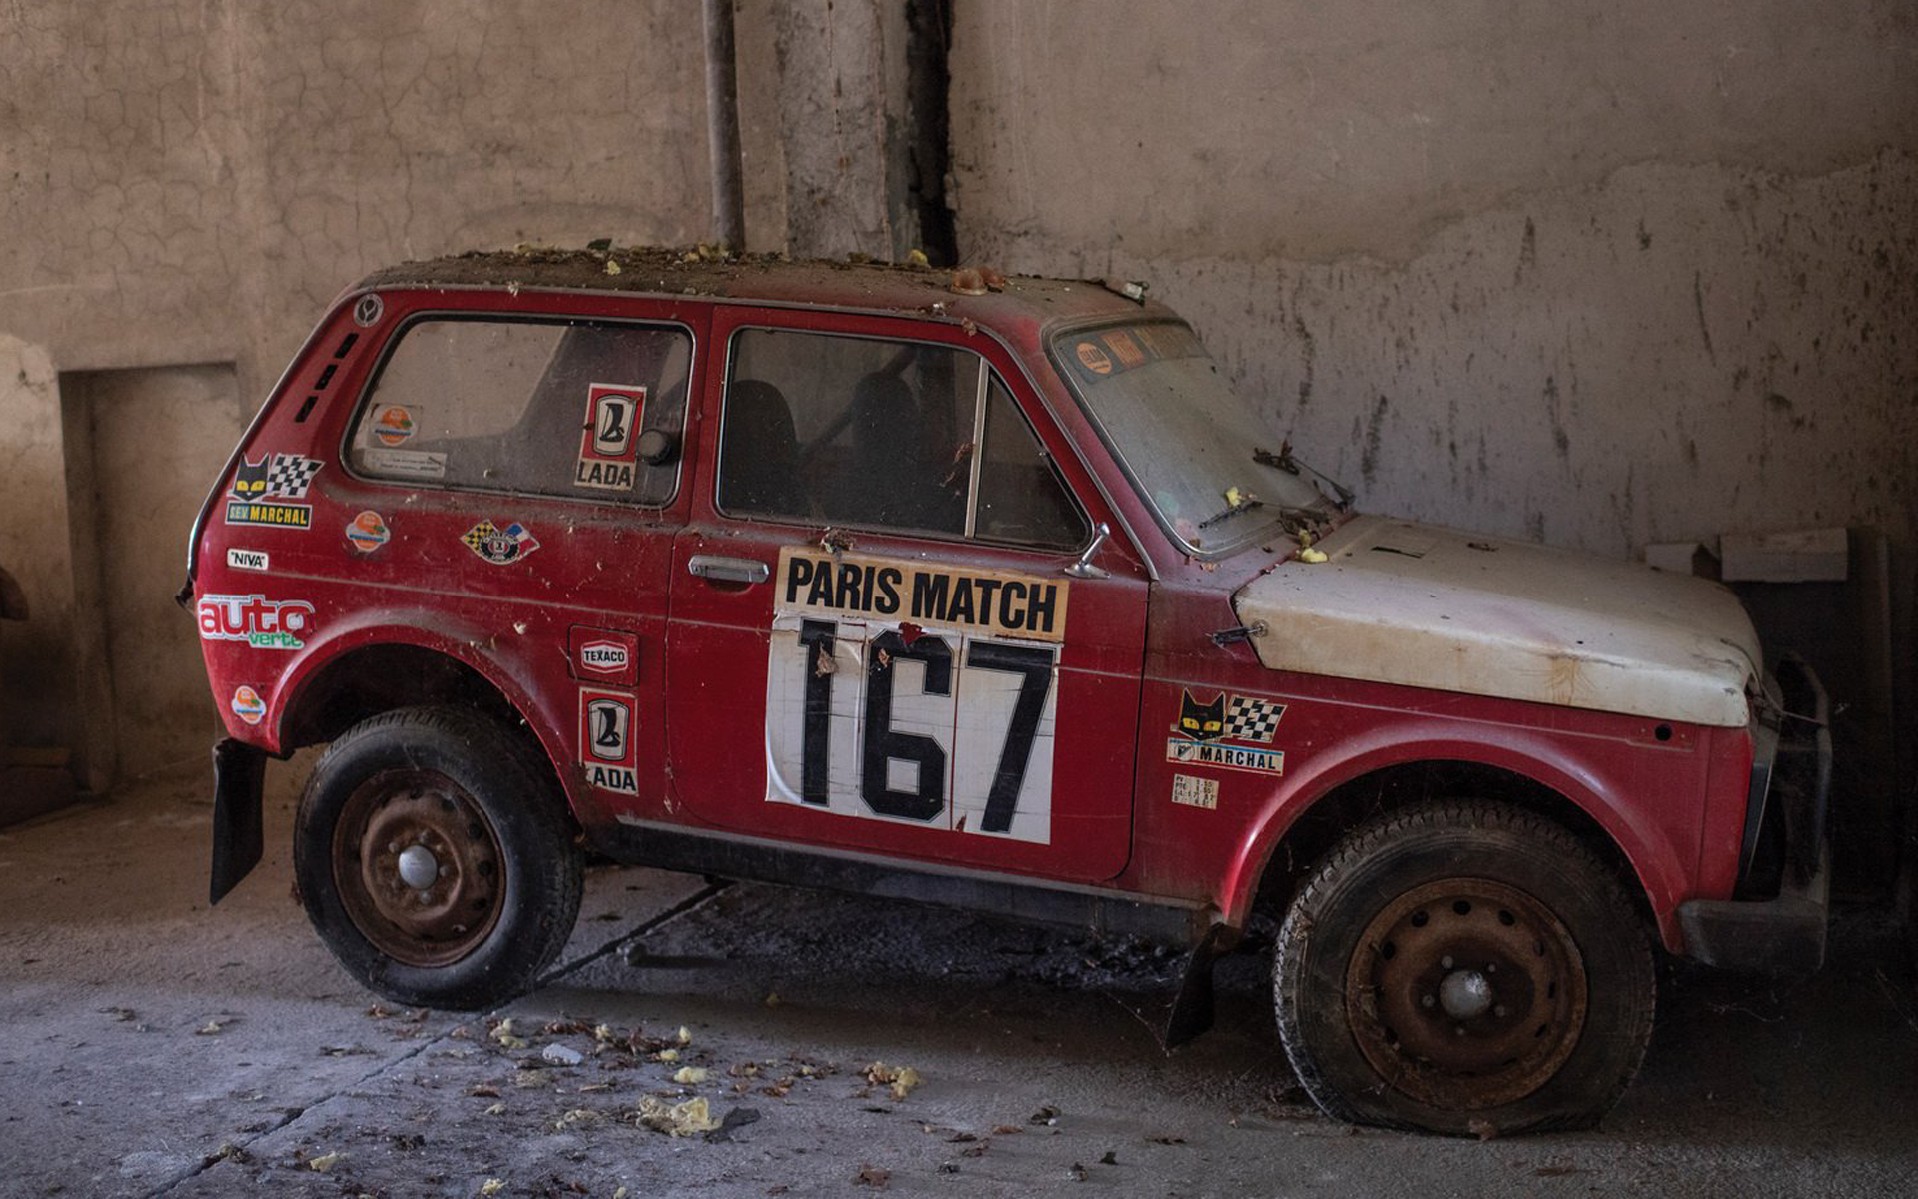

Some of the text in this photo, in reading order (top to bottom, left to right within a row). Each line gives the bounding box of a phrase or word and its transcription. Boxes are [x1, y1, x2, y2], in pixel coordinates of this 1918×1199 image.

[577, 462, 631, 486] LADA
[250, 506, 307, 525] MARCHAL
[787, 557, 1057, 633] PARIS MATCH
[200, 597, 314, 636] auto
[584, 651, 625, 662] TEXACO
[798, 615, 1057, 833] 167
[1200, 746, 1276, 770] MARCHAL
[592, 766, 637, 792] ADA
